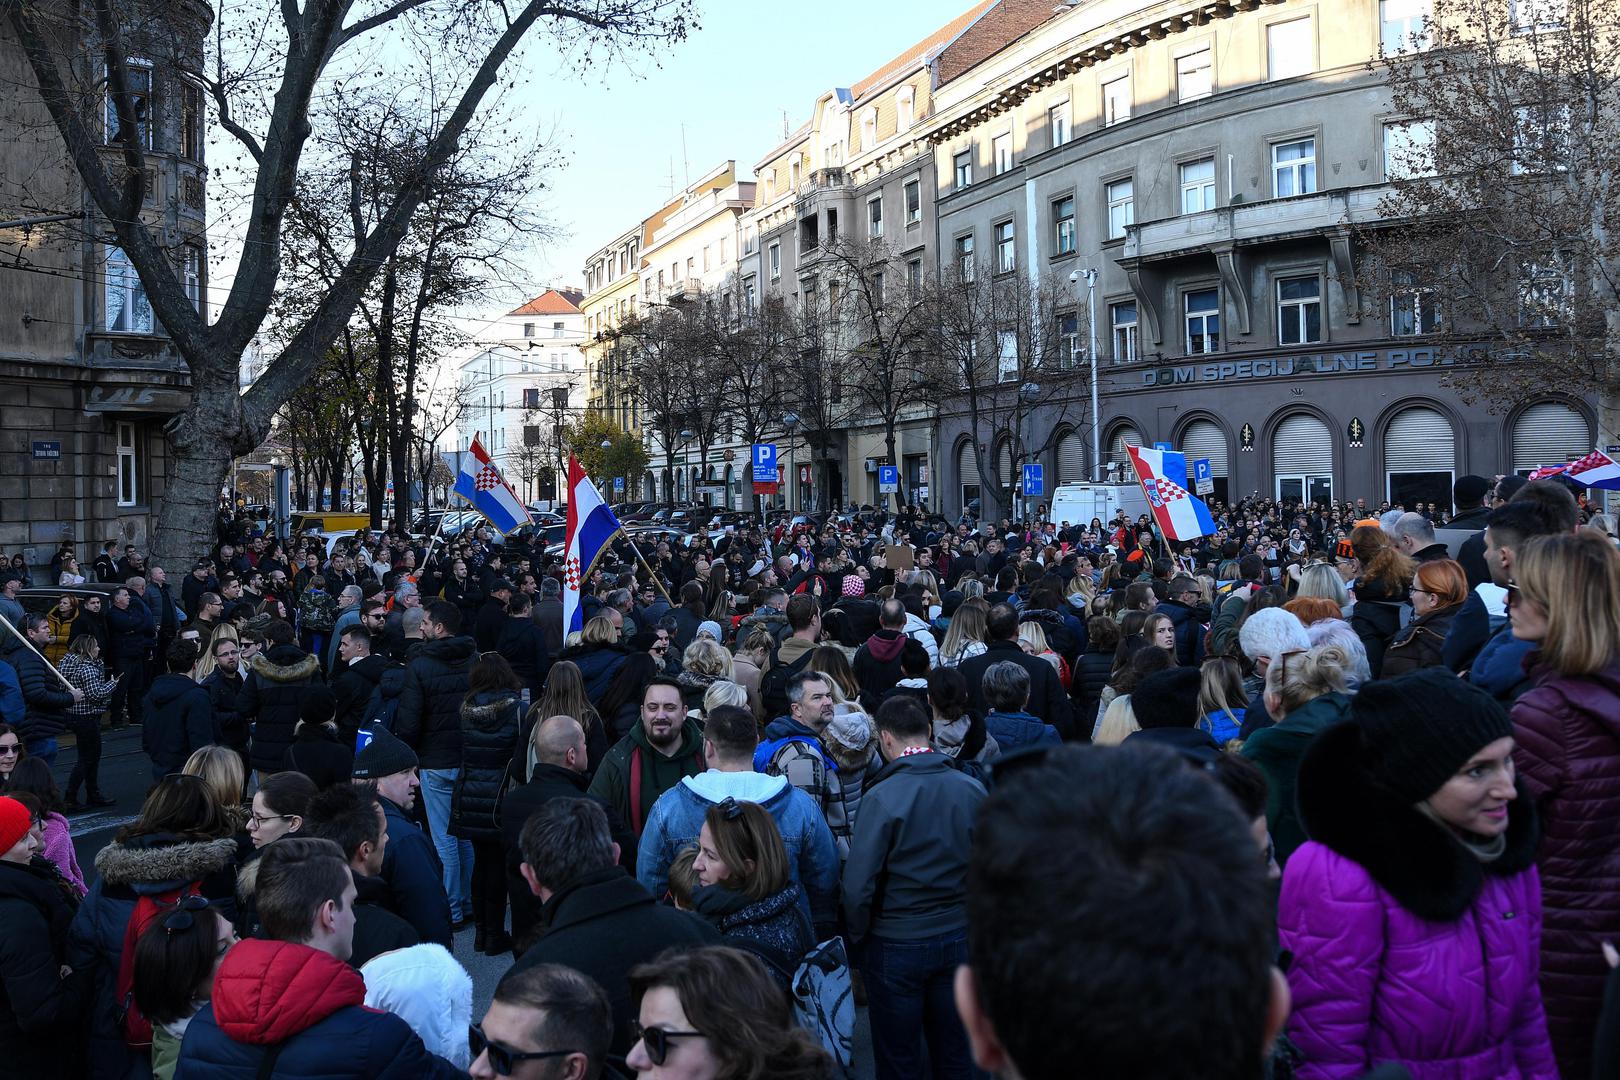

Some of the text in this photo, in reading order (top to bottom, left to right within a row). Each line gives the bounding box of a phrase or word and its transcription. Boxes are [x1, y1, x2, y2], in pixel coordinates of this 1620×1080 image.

[1142, 367, 1195, 387] DOM
[1203, 353, 1377, 381] SPECIJALNE
[759, 446, 771, 464] P
[884, 469, 893, 481] P
[1198, 463, 1206, 479] P
